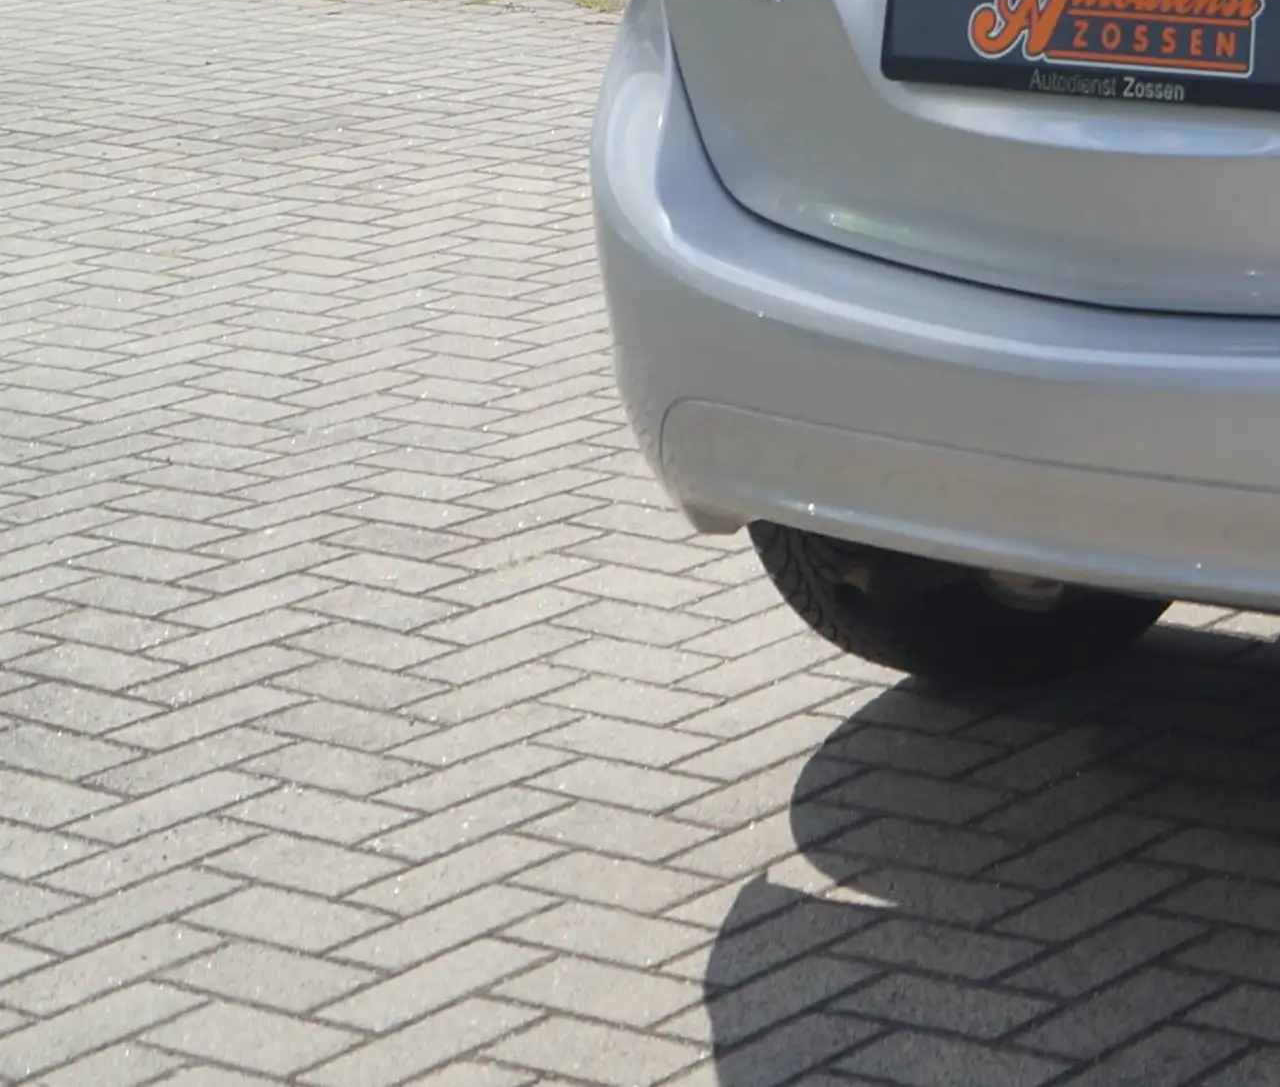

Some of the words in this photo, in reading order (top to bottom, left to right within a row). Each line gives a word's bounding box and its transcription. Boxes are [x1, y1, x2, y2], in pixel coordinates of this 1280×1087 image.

[1072, 19, 1237, 58] ZOSSEN
[1029, 68, 1118, 97] Autodienst
[1122, 76, 1185, 102] Zossen
